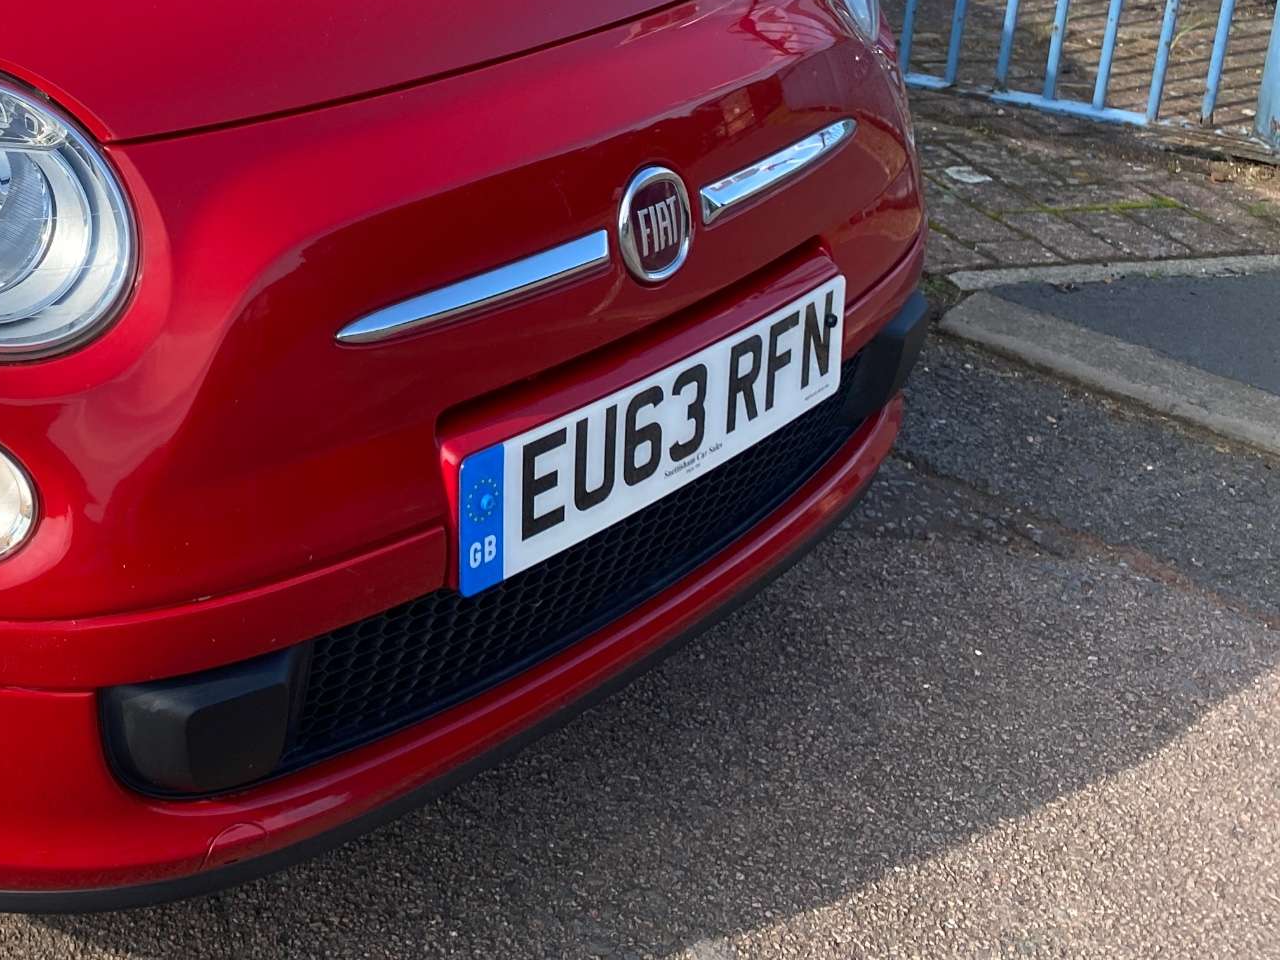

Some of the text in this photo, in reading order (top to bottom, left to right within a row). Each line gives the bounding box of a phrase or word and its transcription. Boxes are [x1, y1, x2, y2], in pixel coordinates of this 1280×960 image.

[637, 195, 680, 257] FIAT
[521, 290, 834, 541] EU63 RFN
[469, 534, 496, 569] GB
